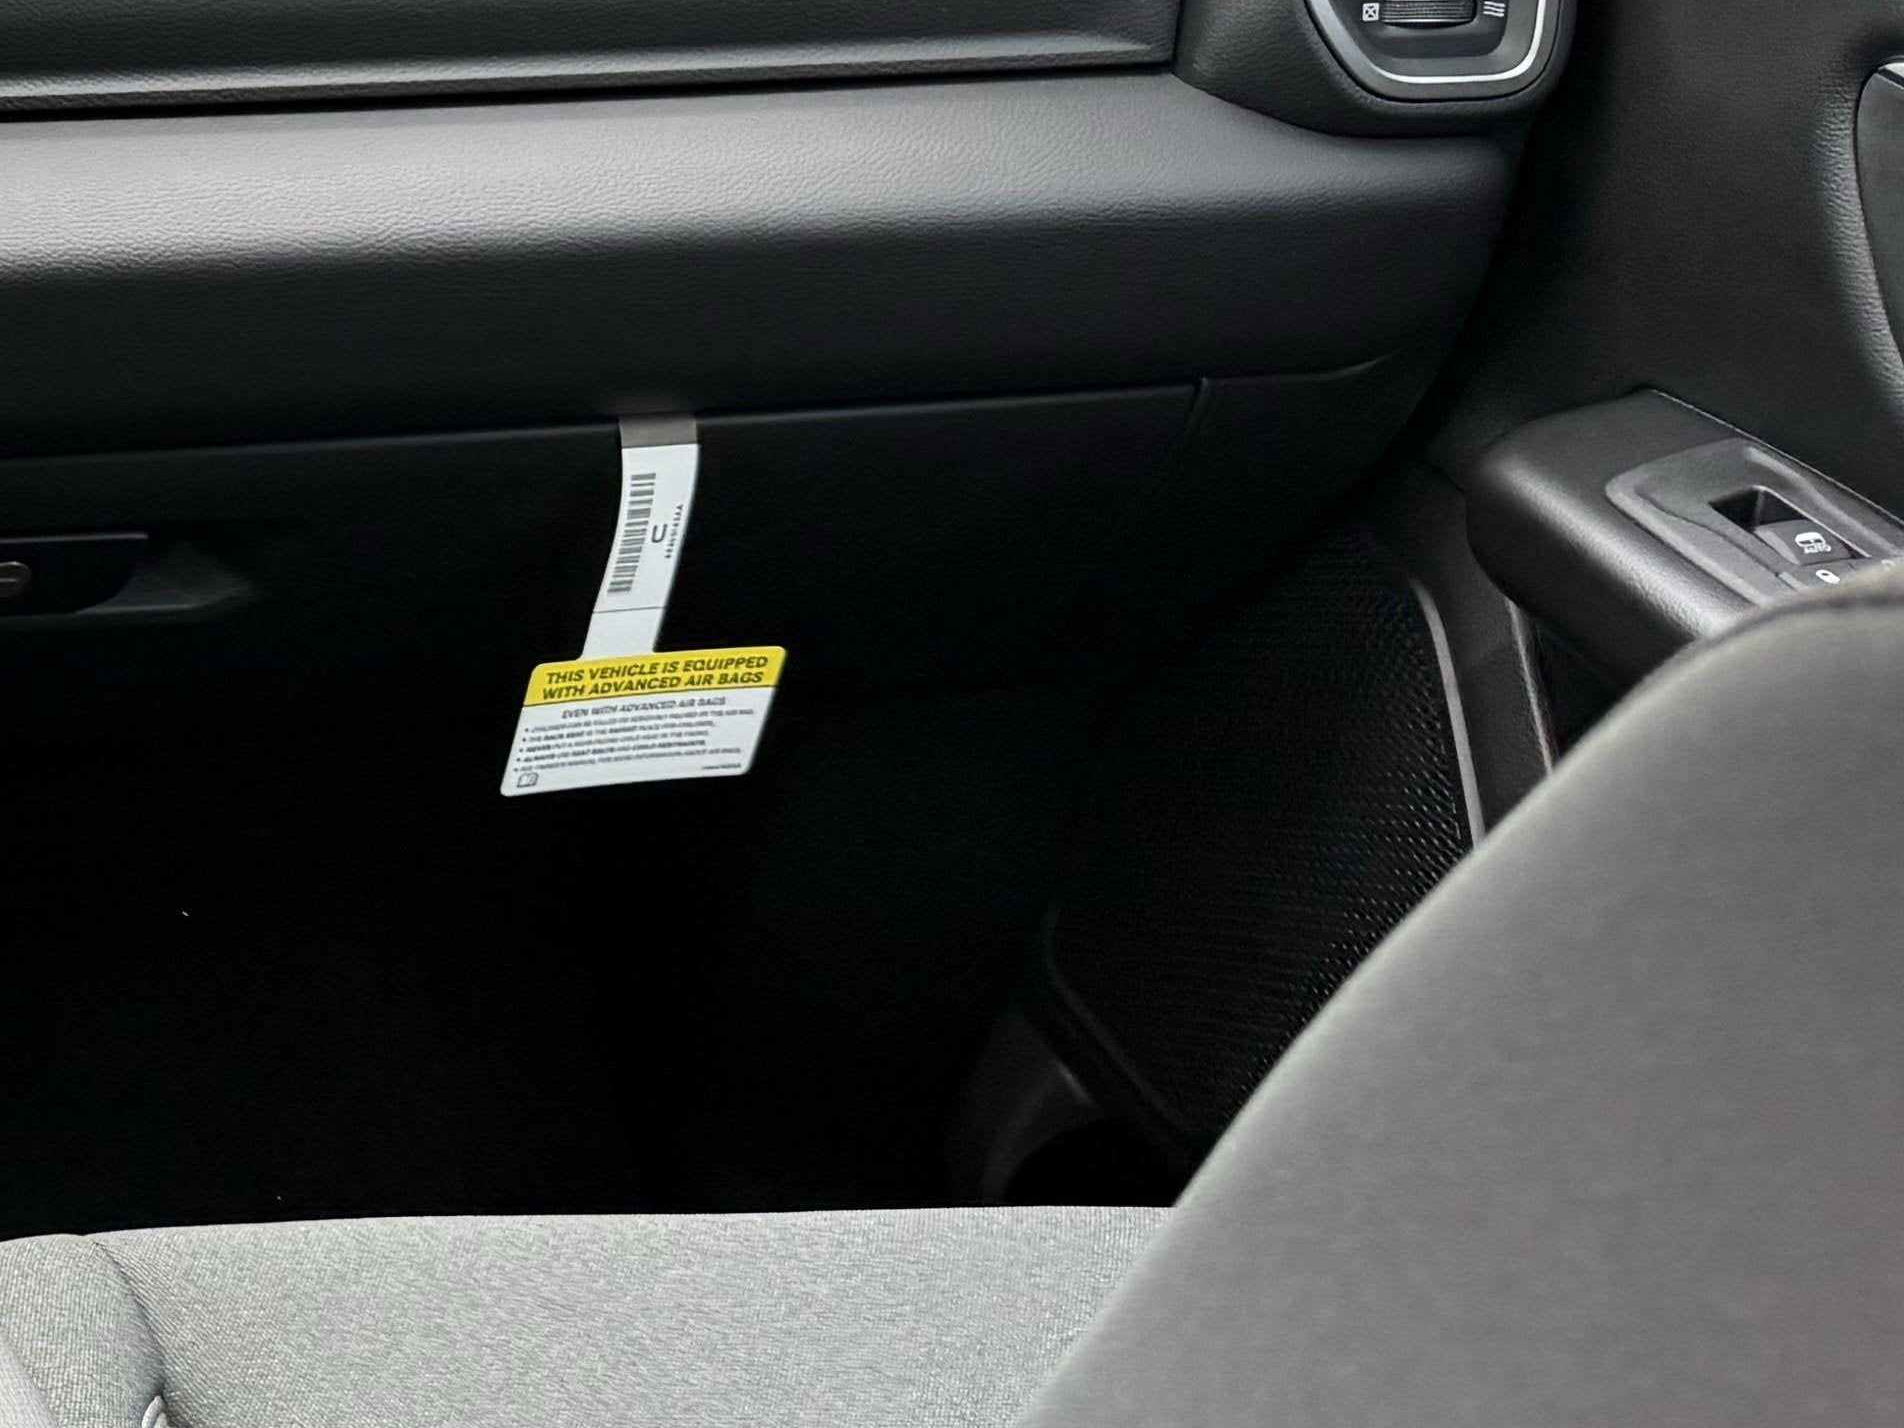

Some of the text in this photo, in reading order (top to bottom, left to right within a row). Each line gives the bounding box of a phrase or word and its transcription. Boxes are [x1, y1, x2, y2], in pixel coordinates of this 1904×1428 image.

[546, 656, 768, 685] THIS VEHICLE IS EQUIPPED
[542, 671, 763, 700] WITH ADVANCED AIR BAGS
